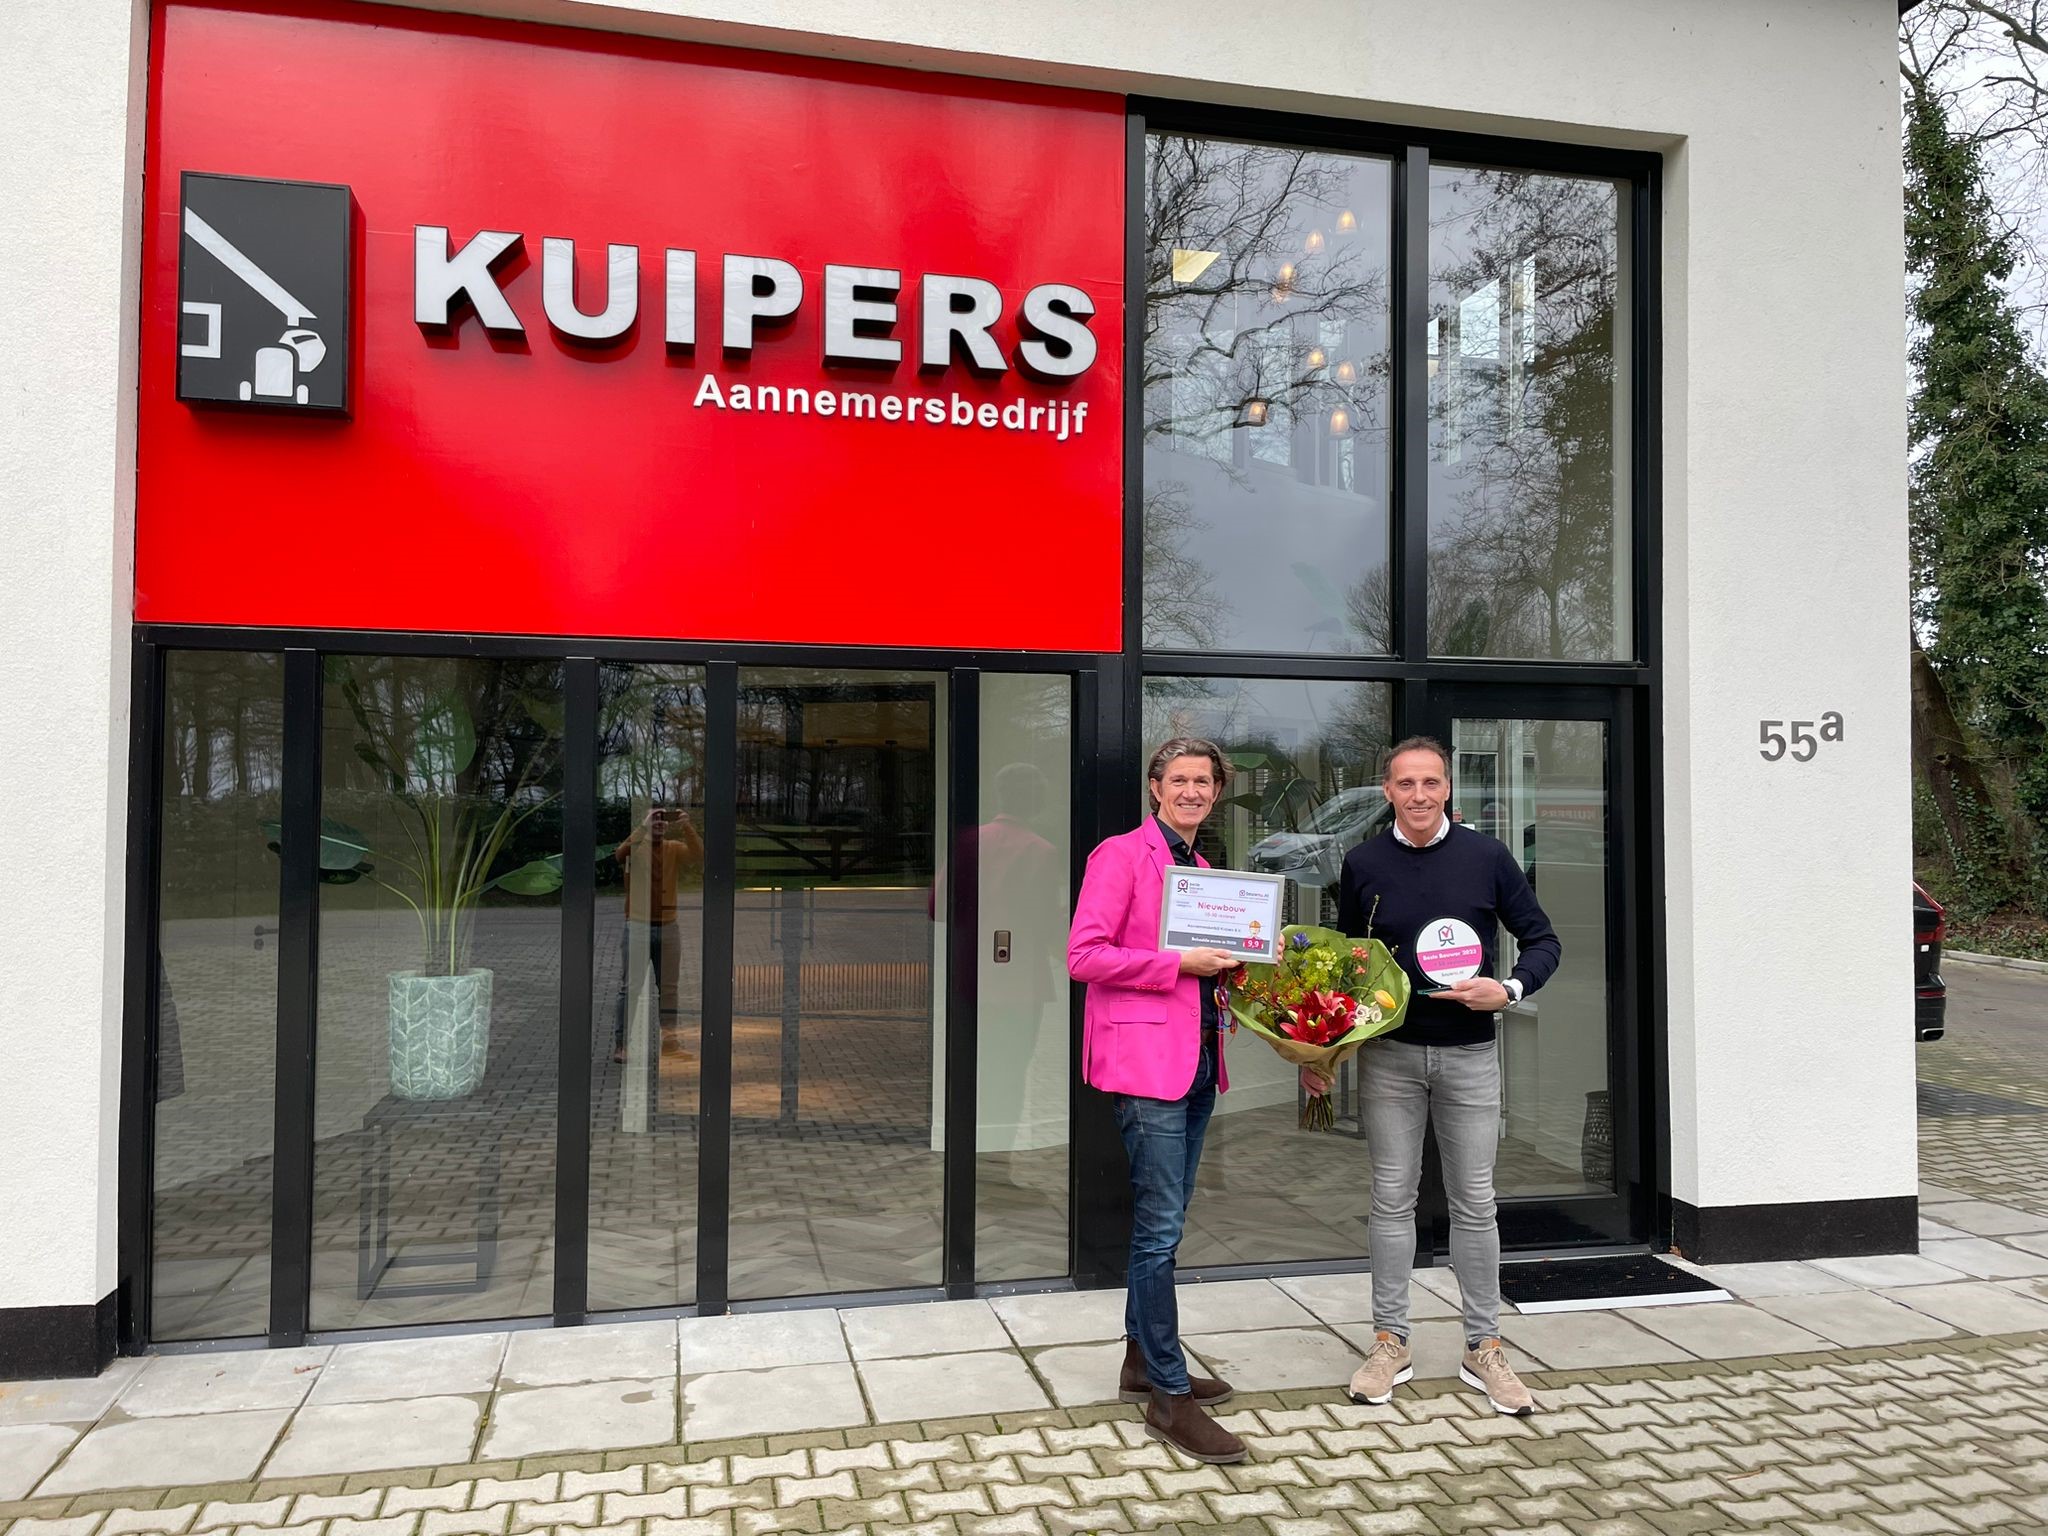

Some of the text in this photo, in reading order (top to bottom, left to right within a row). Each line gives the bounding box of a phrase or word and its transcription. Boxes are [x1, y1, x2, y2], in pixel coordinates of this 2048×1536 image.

[413, 224, 1099, 380] KUIPERS
[692, 373, 1089, 442] Aannemersbedrijf
[1197, 901, 1247, 913] Nieuwbouw
[1247, 939, 1260, 949] 9,9
